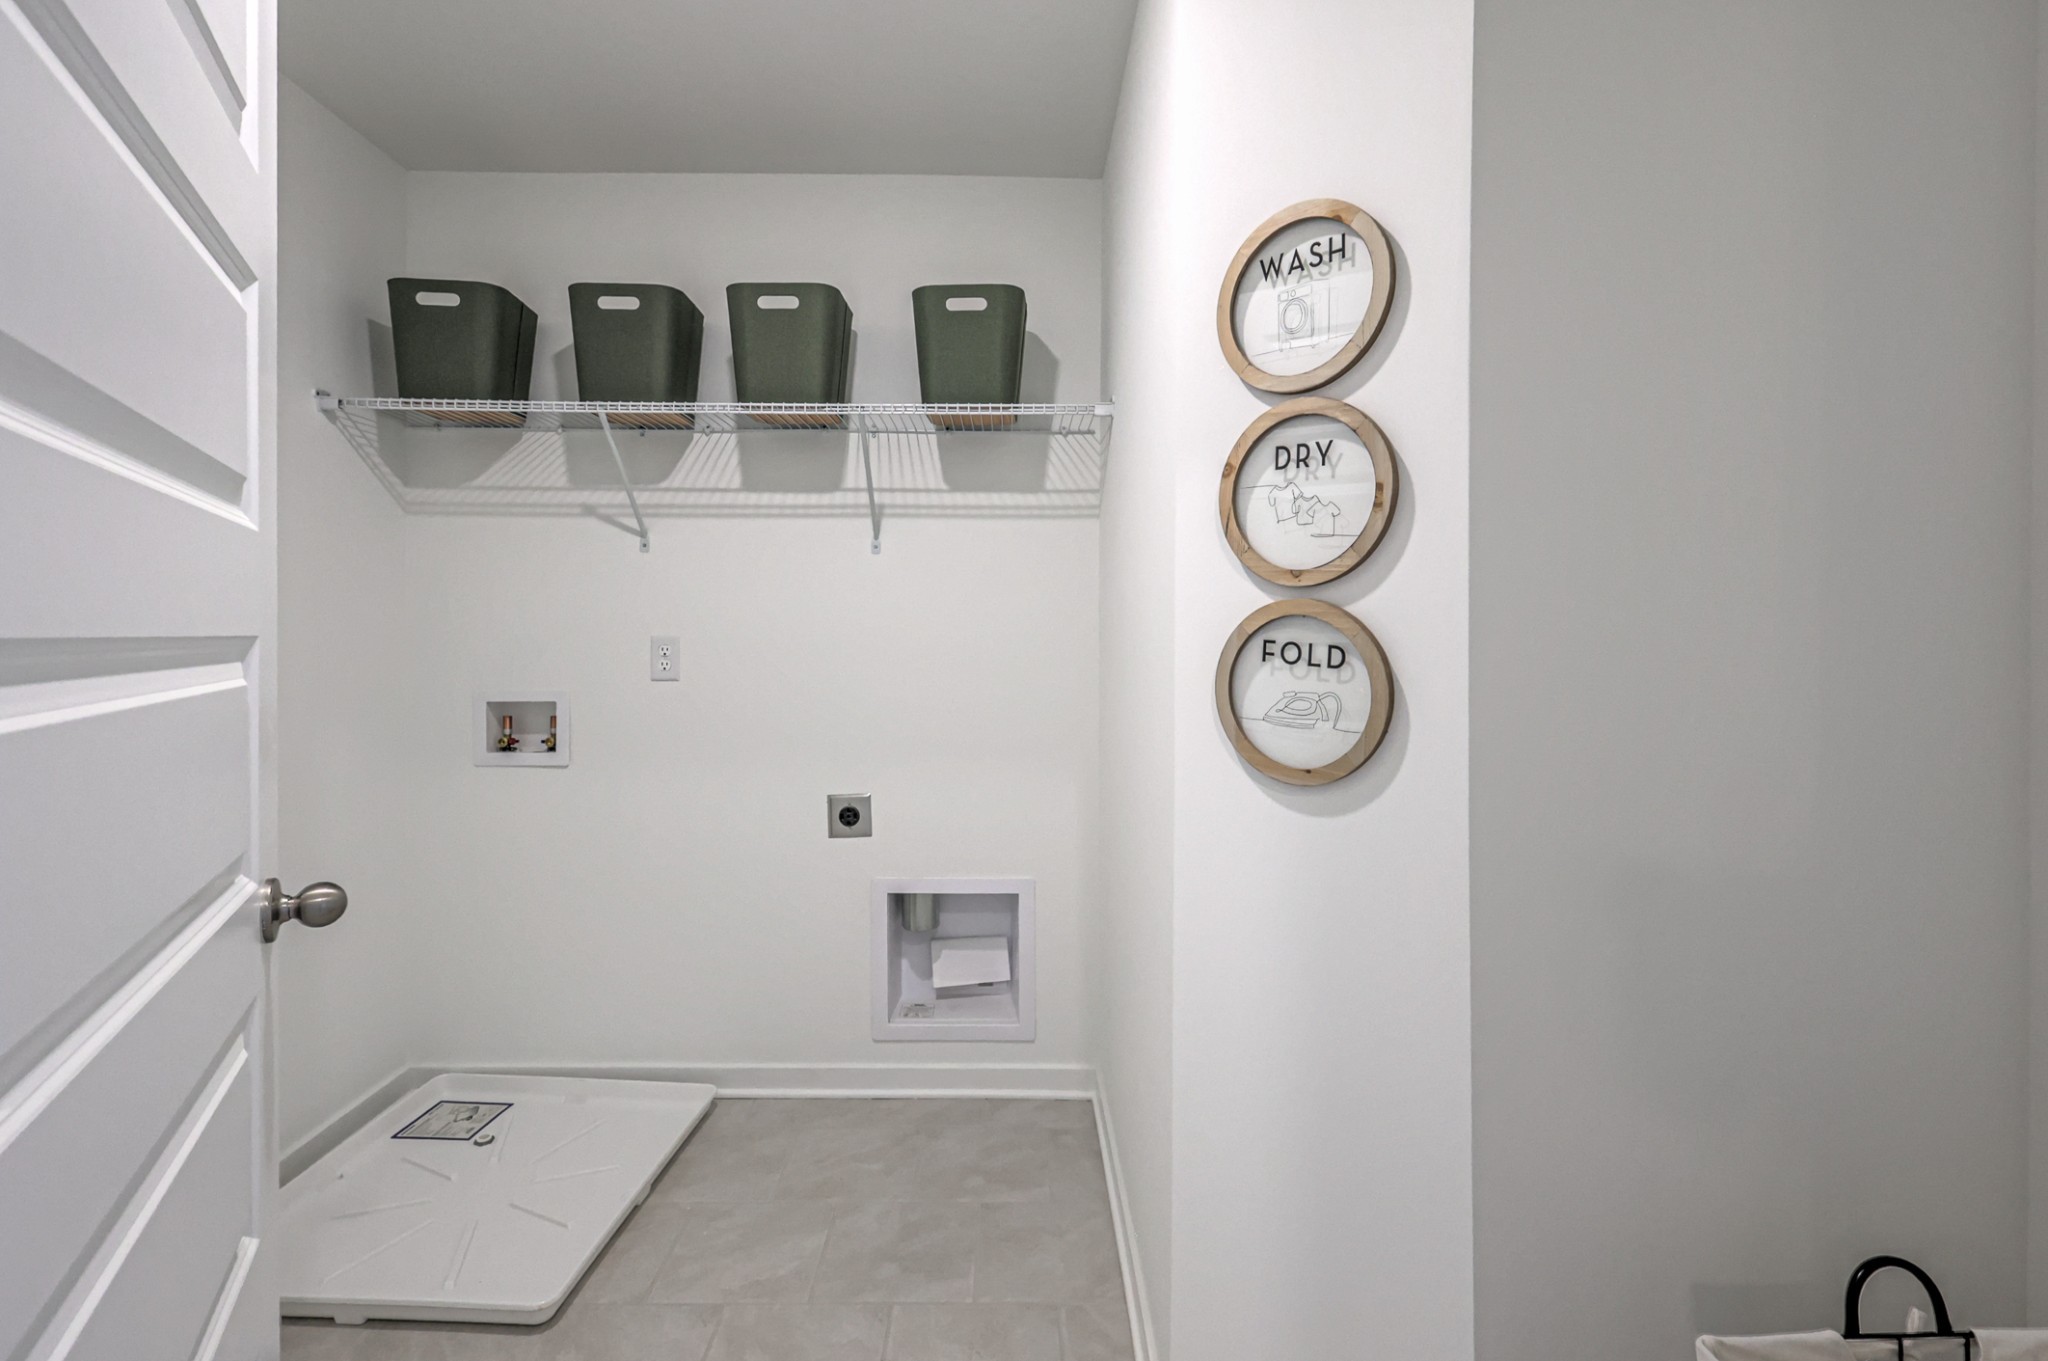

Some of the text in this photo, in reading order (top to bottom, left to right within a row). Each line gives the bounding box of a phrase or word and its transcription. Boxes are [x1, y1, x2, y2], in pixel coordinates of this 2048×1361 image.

[1260, 233, 1345, 282] WASH
[1275, 440, 1334, 470] DRY
[1262, 639, 1346, 669] FOLD
